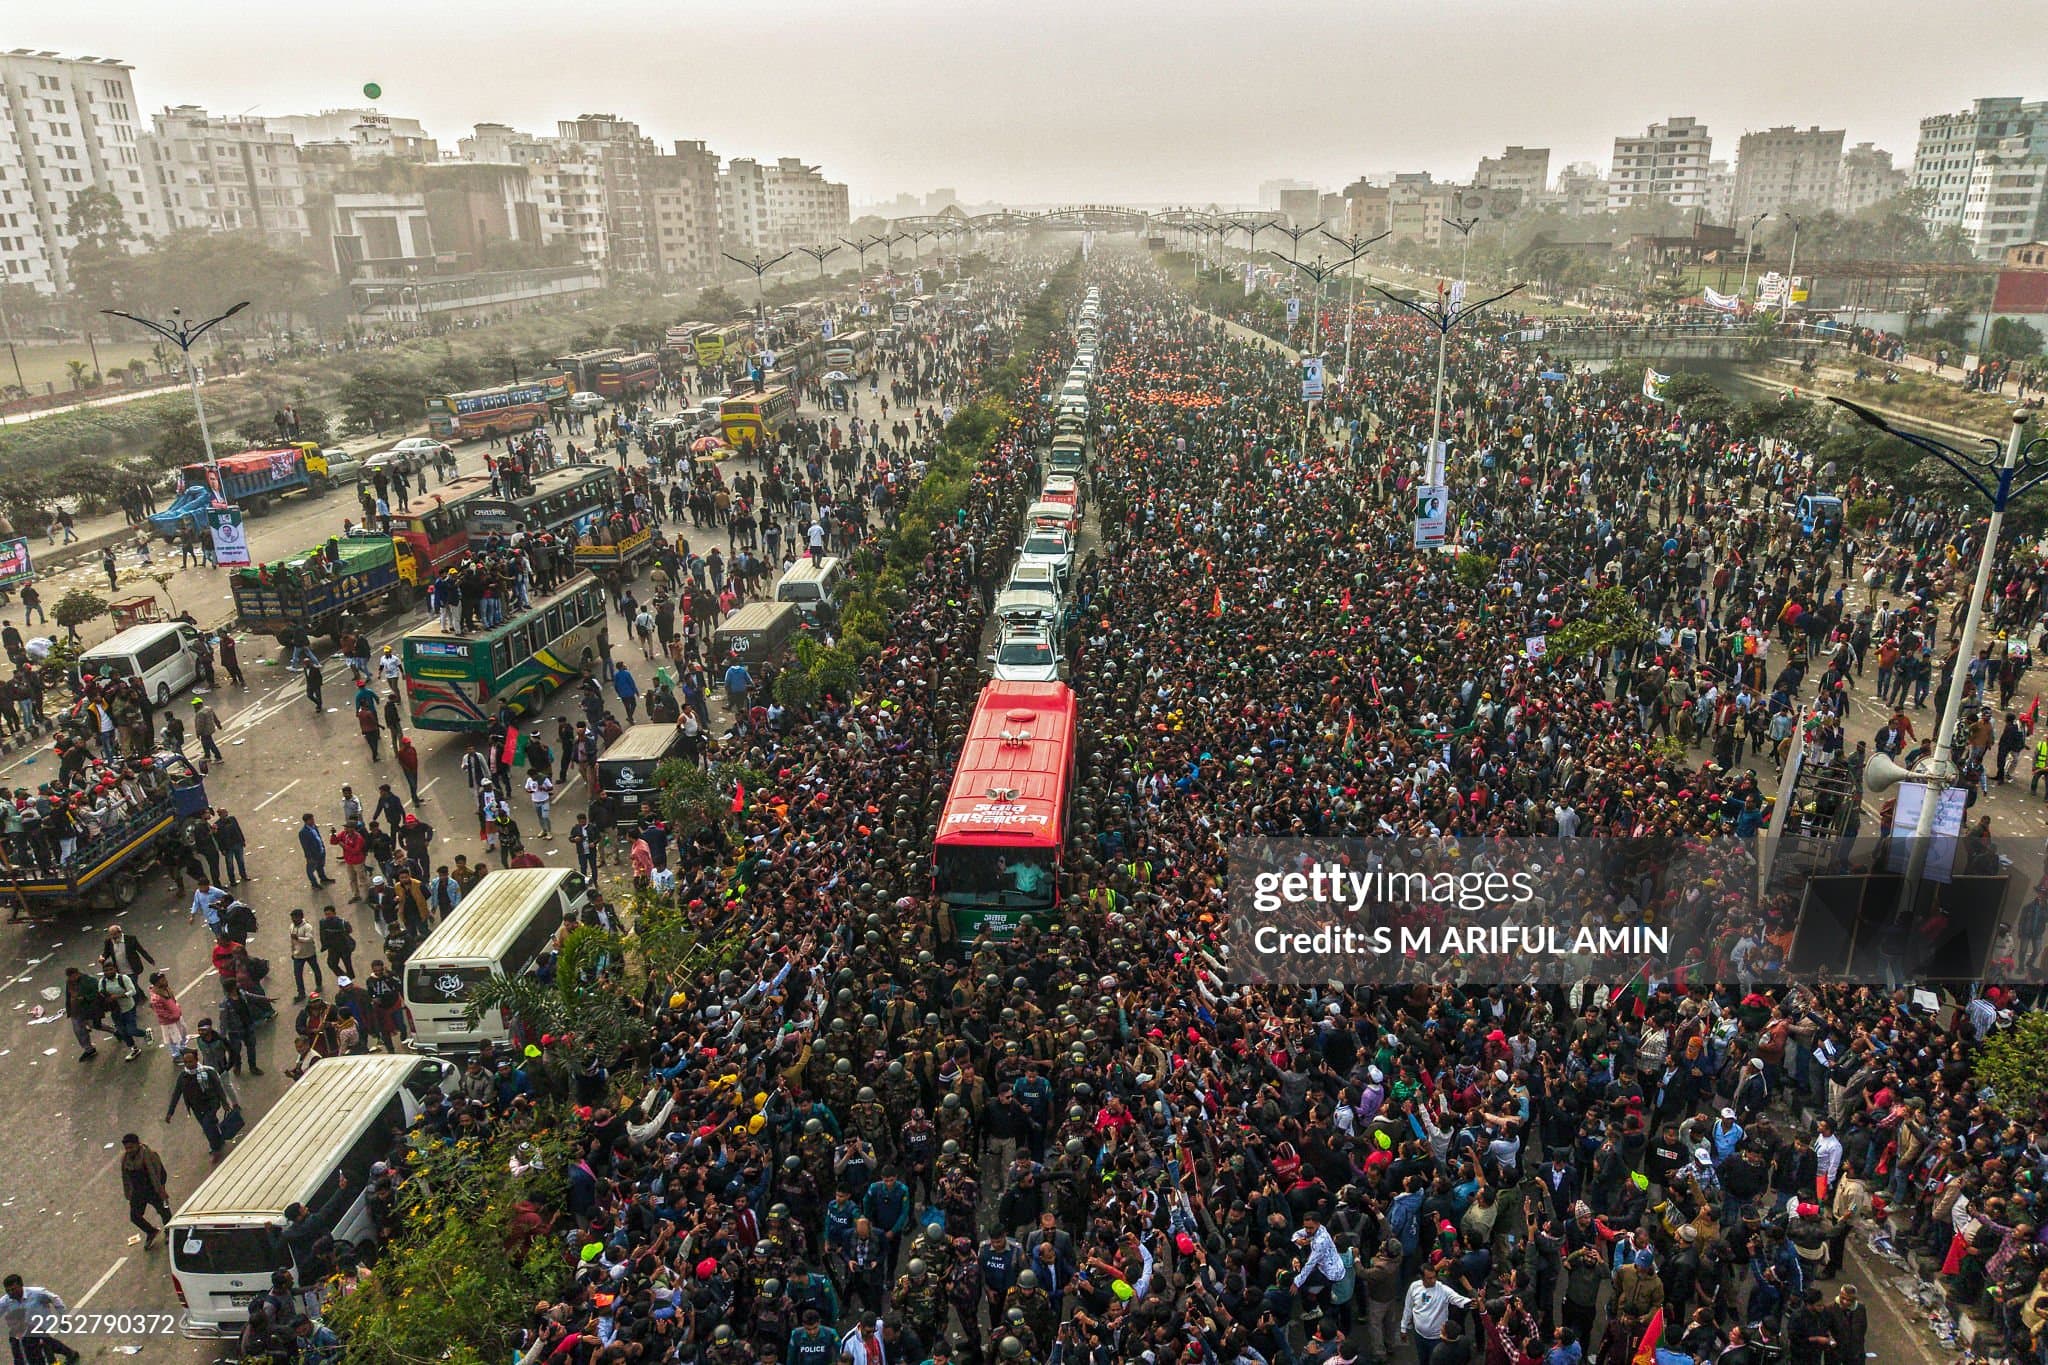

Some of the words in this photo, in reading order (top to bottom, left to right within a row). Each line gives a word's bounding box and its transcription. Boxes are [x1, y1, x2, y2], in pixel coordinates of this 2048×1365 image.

[973, 803, 1027, 814] সবার
[986, 1261, 1005, 1270] POLICE
[800, 1345, 825, 1353] POLICE
